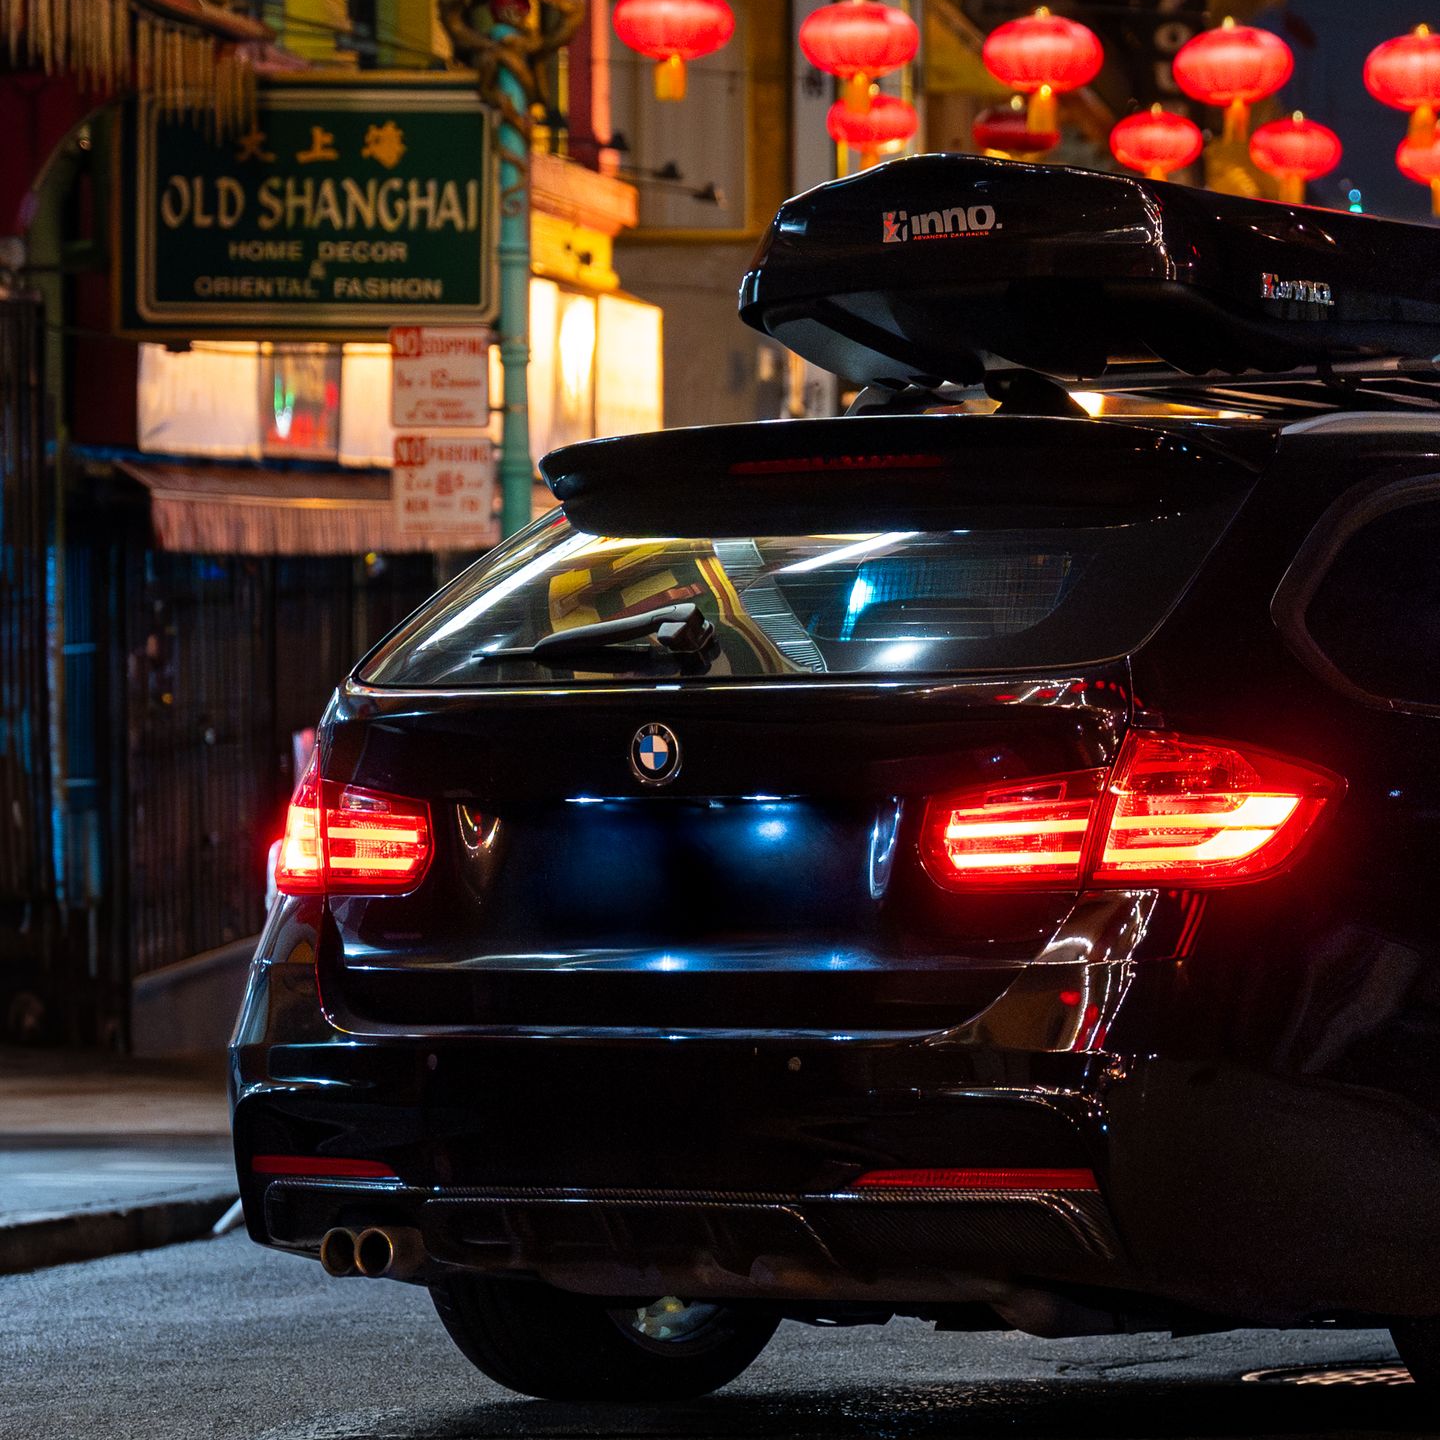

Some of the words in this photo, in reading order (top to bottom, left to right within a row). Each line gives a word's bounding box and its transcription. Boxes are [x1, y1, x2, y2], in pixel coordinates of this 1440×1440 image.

[161, 175, 246, 229] OLD
[257, 175, 479, 231] SHANGHAI
[228, 239, 304, 262] HOME
[317, 240, 409, 263] DECOR
[193, 275, 321, 298] ORIENTAL
[333, 277, 443, 300] FASHION
